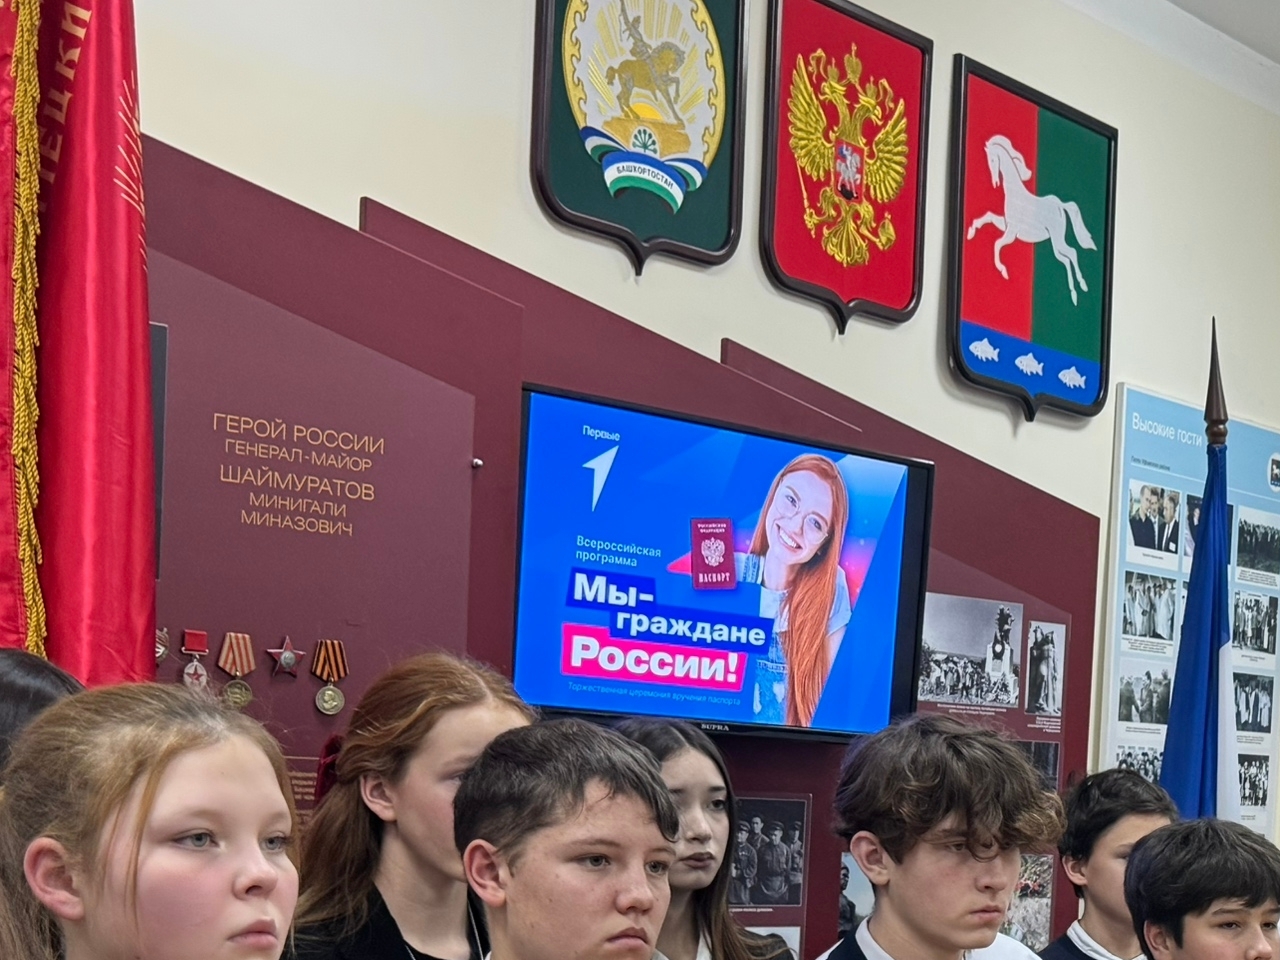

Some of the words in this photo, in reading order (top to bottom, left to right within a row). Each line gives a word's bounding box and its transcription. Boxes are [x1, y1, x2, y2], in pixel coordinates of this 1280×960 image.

[213, 412, 287, 440] ГЕРОЙ
[293, 425, 385, 455] РОССИИ
[582, 425, 621, 441] Первые
[1131, 412, 1175, 440] Высокие
[1177, 429, 1203, 447] гости
[225, 438, 373, 472] ГЕНЕРАЛ-МАЙОР
[220, 464, 375, 501] ШАЙМУРАТОВ
[249, 492, 347, 518] МИНИГАЛИ
[241, 509, 353, 537] МИНАЗОВИЧ
[575, 550, 637, 567] программа
[576, 535, 662, 557] Всероссийская
[698, 572, 731, 583] ПАСПОРТ
[616, 611, 766, 646] граждане
[570, 635, 738, 683] России!
[700, 723, 730, 732] SUPRA
